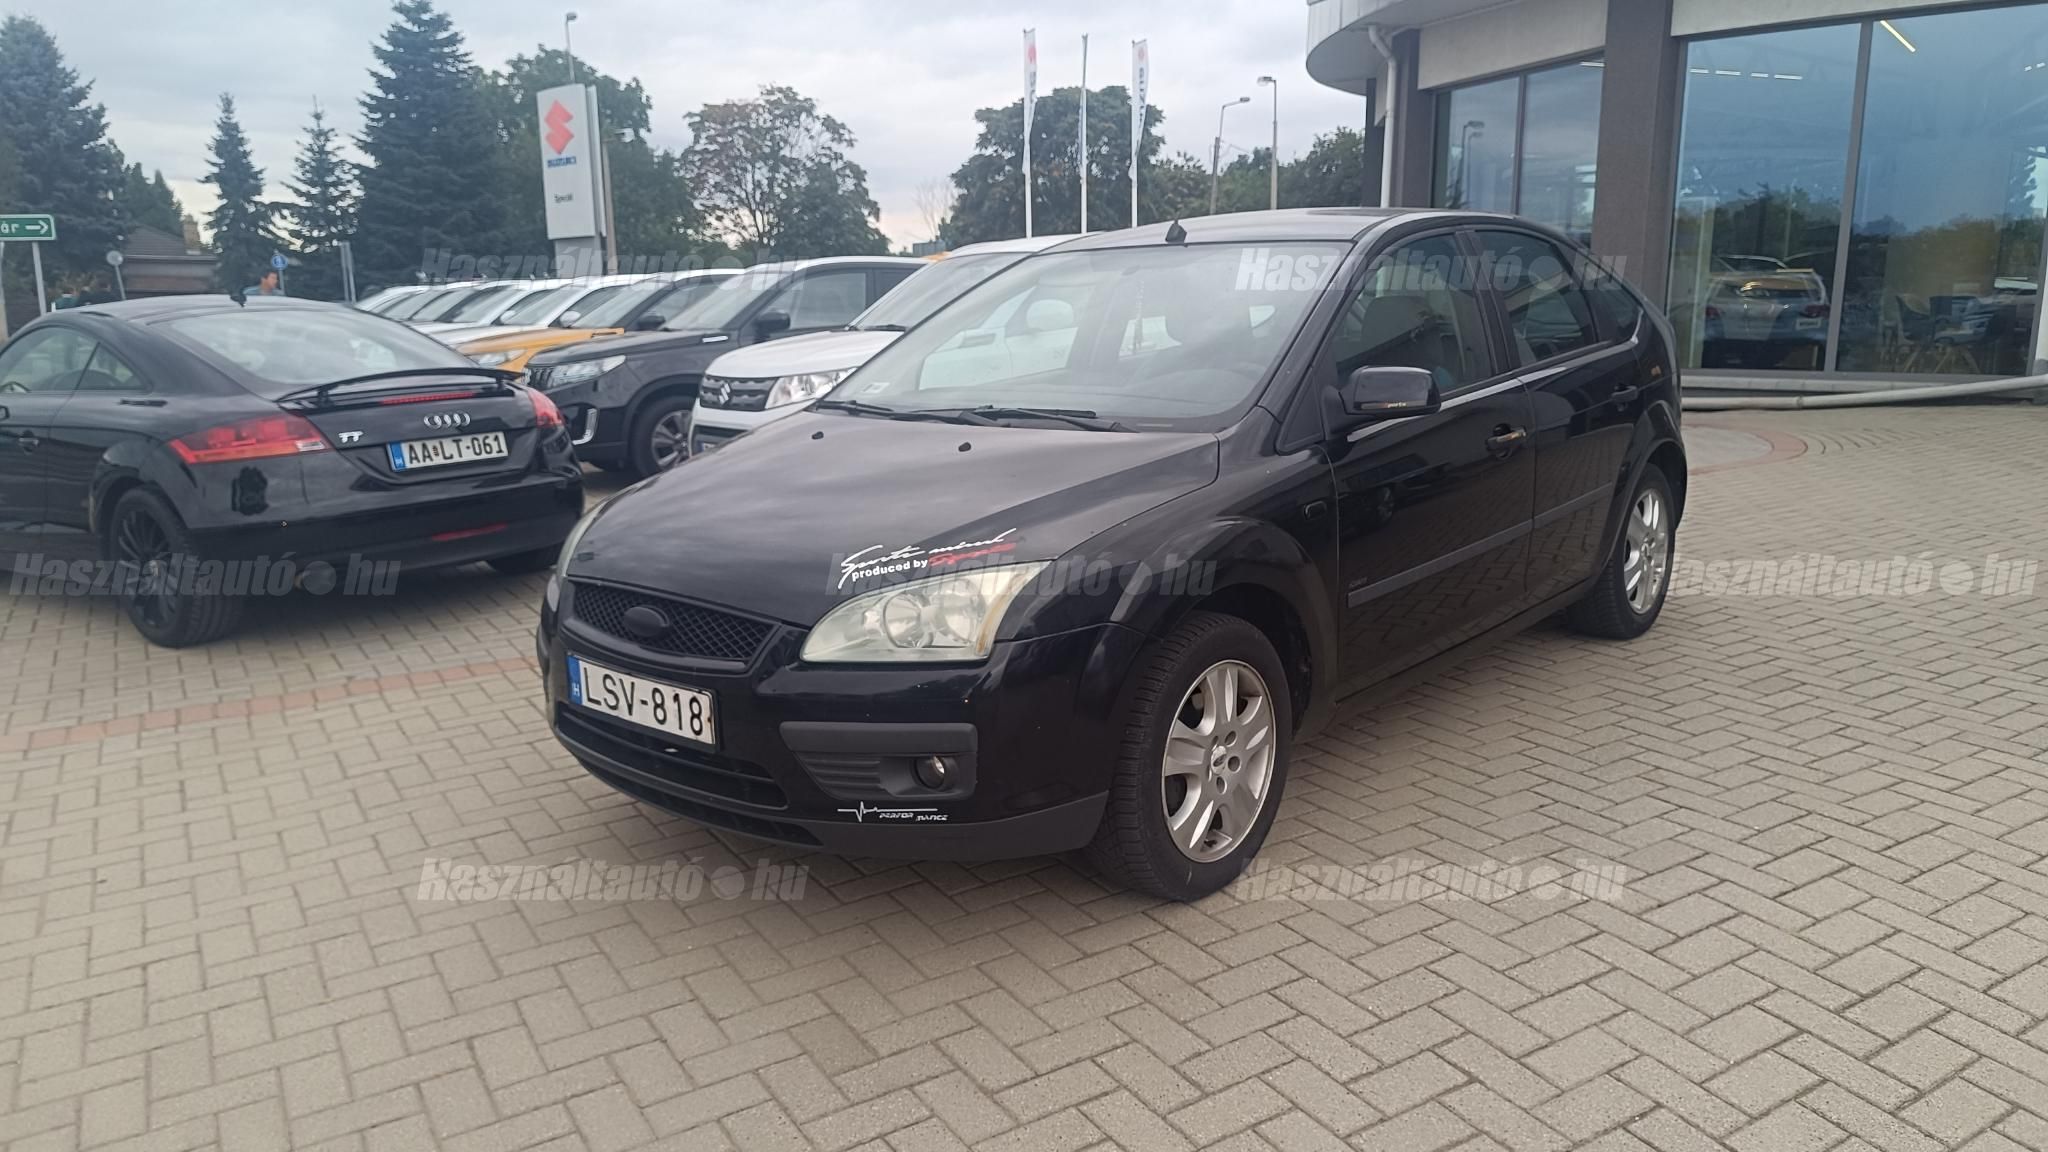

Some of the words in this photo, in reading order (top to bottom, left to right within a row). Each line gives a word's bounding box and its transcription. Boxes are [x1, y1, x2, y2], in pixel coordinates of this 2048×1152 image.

[851, 561, 911, 583] produced
[913, 559, 929, 569] by
[583, 667, 704, 736] LSV-818
